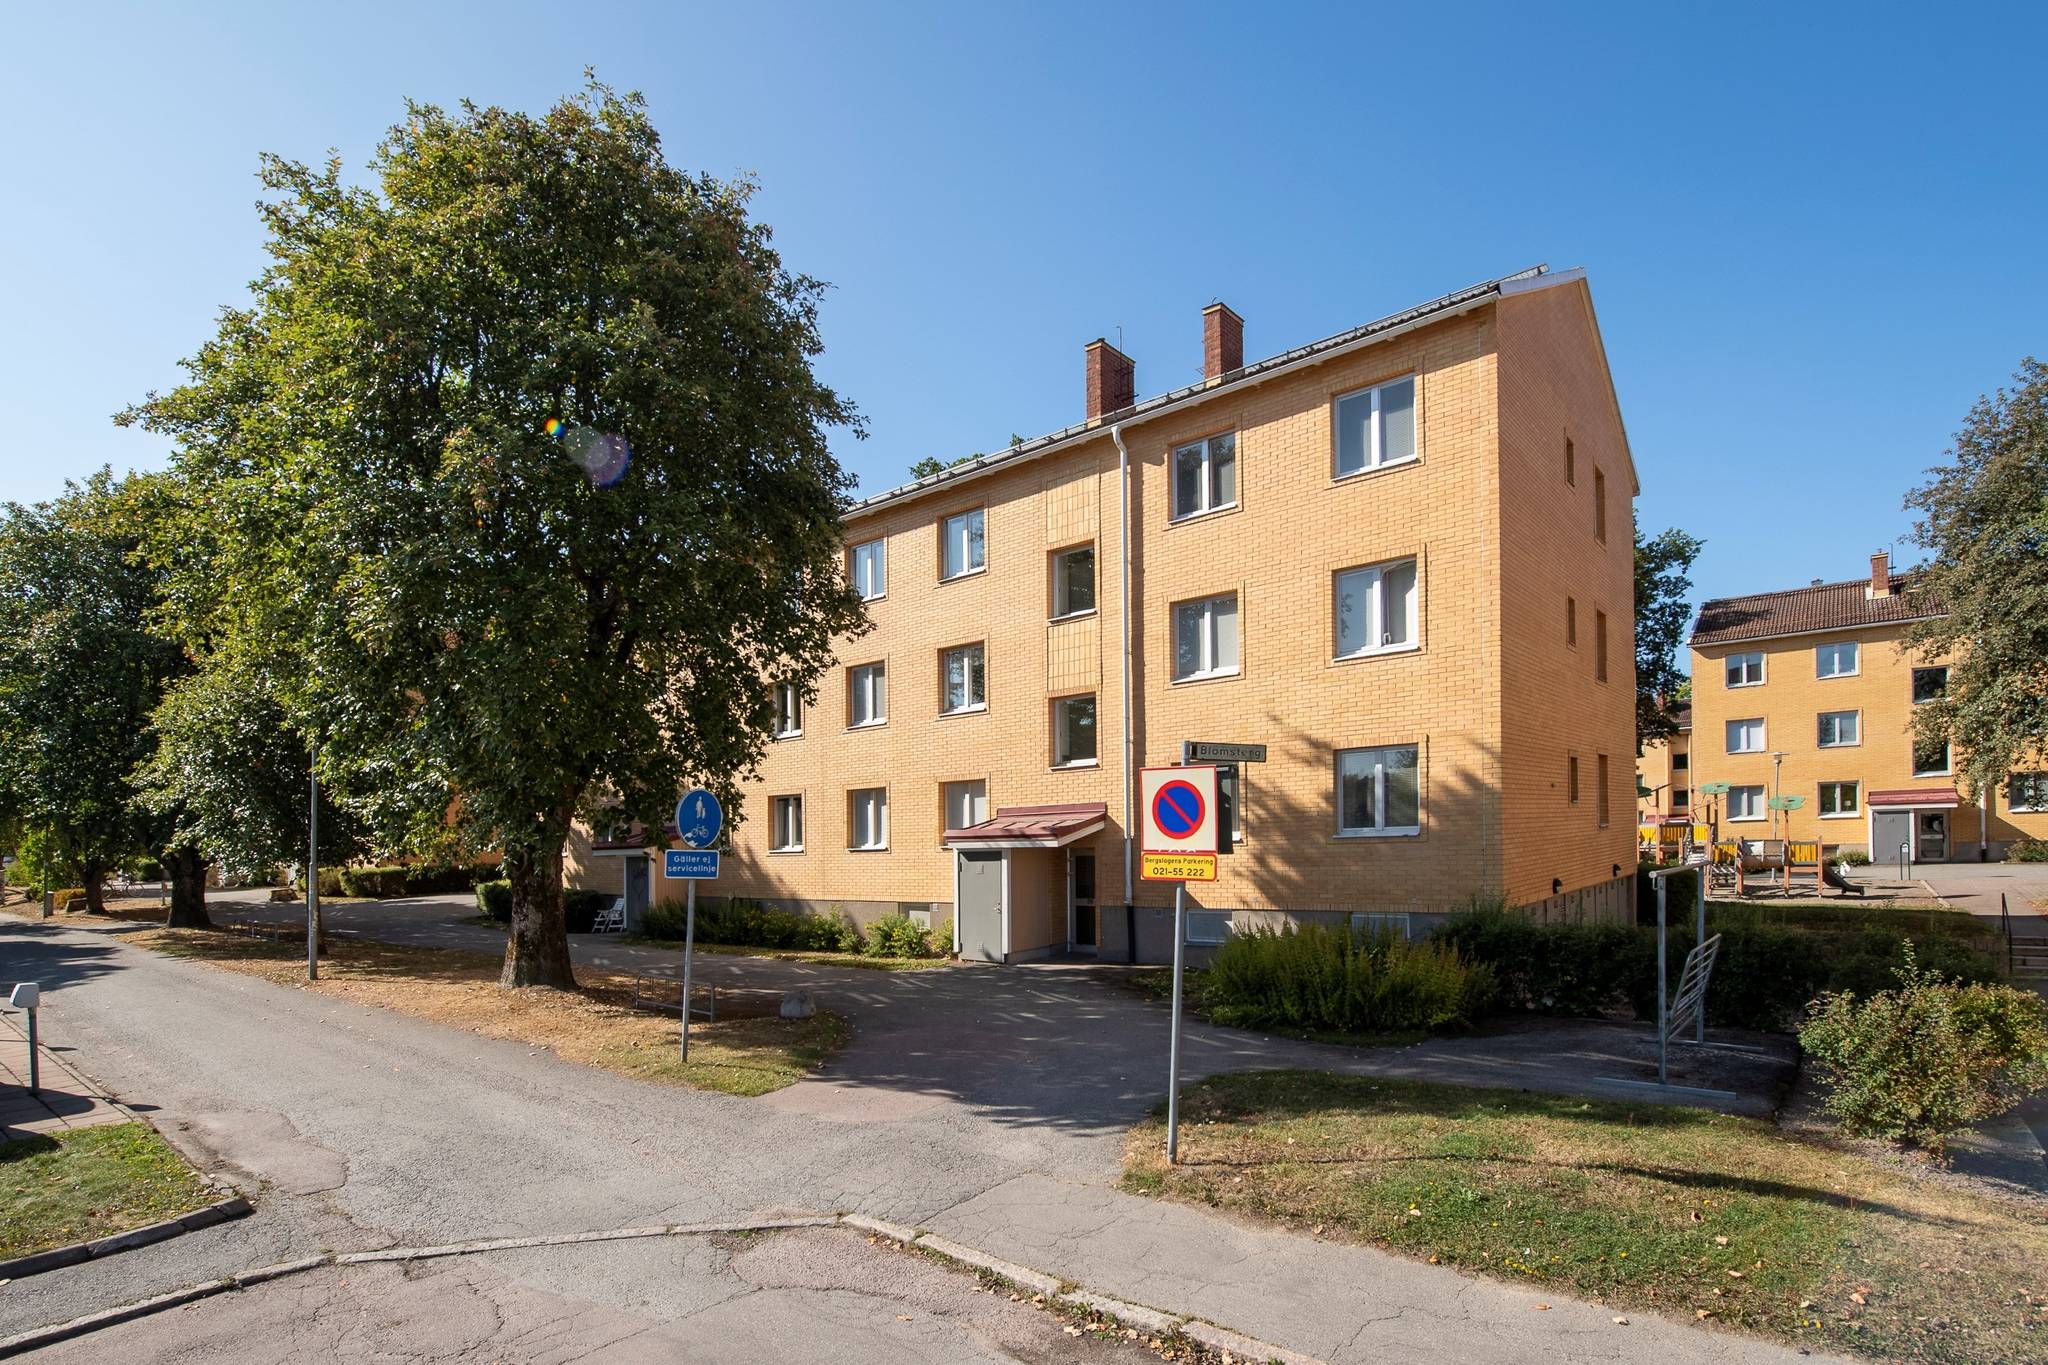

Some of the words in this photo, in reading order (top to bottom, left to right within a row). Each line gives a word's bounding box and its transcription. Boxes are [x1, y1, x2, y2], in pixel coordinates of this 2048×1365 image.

[673, 855, 701, 863] Gäller
[702, 856, 711, 864] ej
[1183, 858, 1214, 866] Parkering
[667, 865, 717, 873] servicelinje
[1152, 867, 1184, 876] 021-55
[1186, 868, 1205, 877] 222
